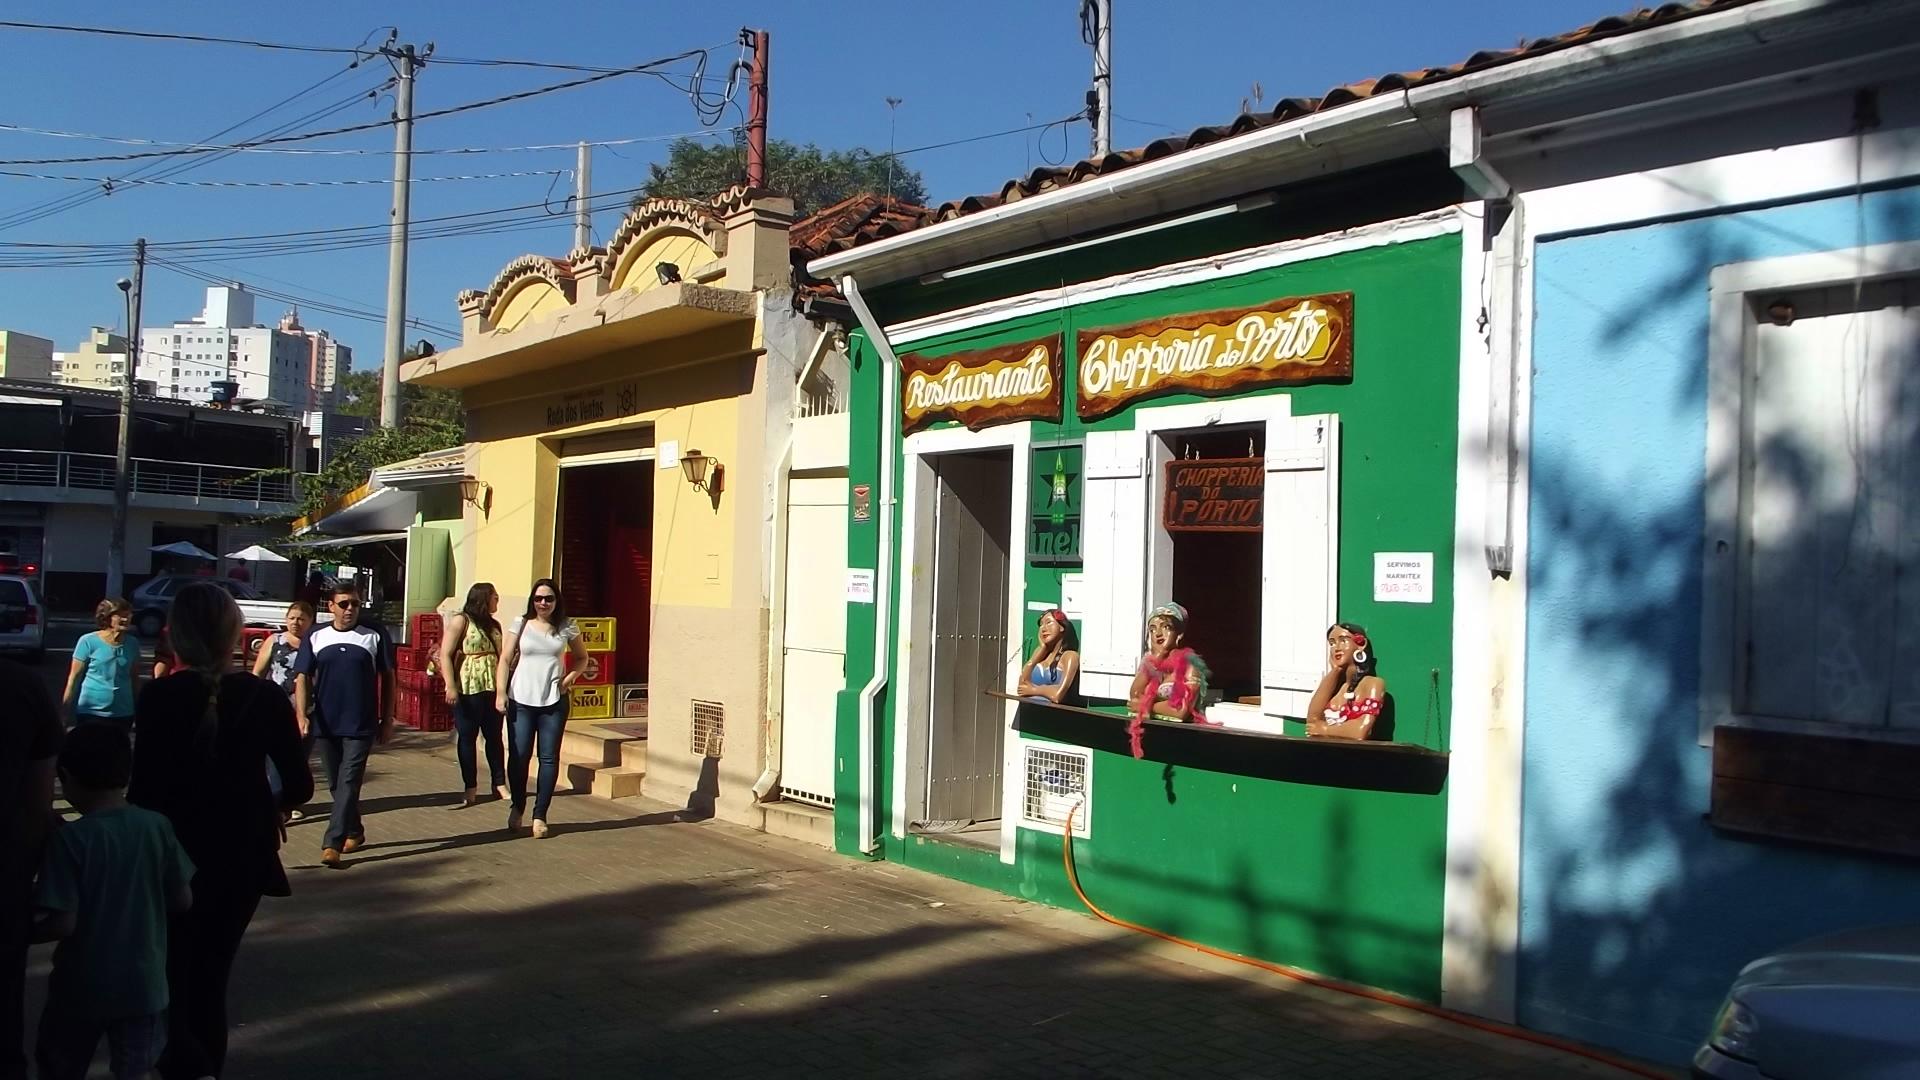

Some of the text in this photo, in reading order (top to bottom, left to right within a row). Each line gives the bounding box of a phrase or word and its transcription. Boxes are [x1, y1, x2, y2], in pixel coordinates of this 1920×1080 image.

[1083, 301, 1328, 395] Chopperia do Porto
[907, 348, 1051, 409] Restaurante
[1176, 466, 1264, 487] CHOPPERIA
[1179, 499, 1259, 521] PORTO
[573, 695, 606, 707] SKOL
